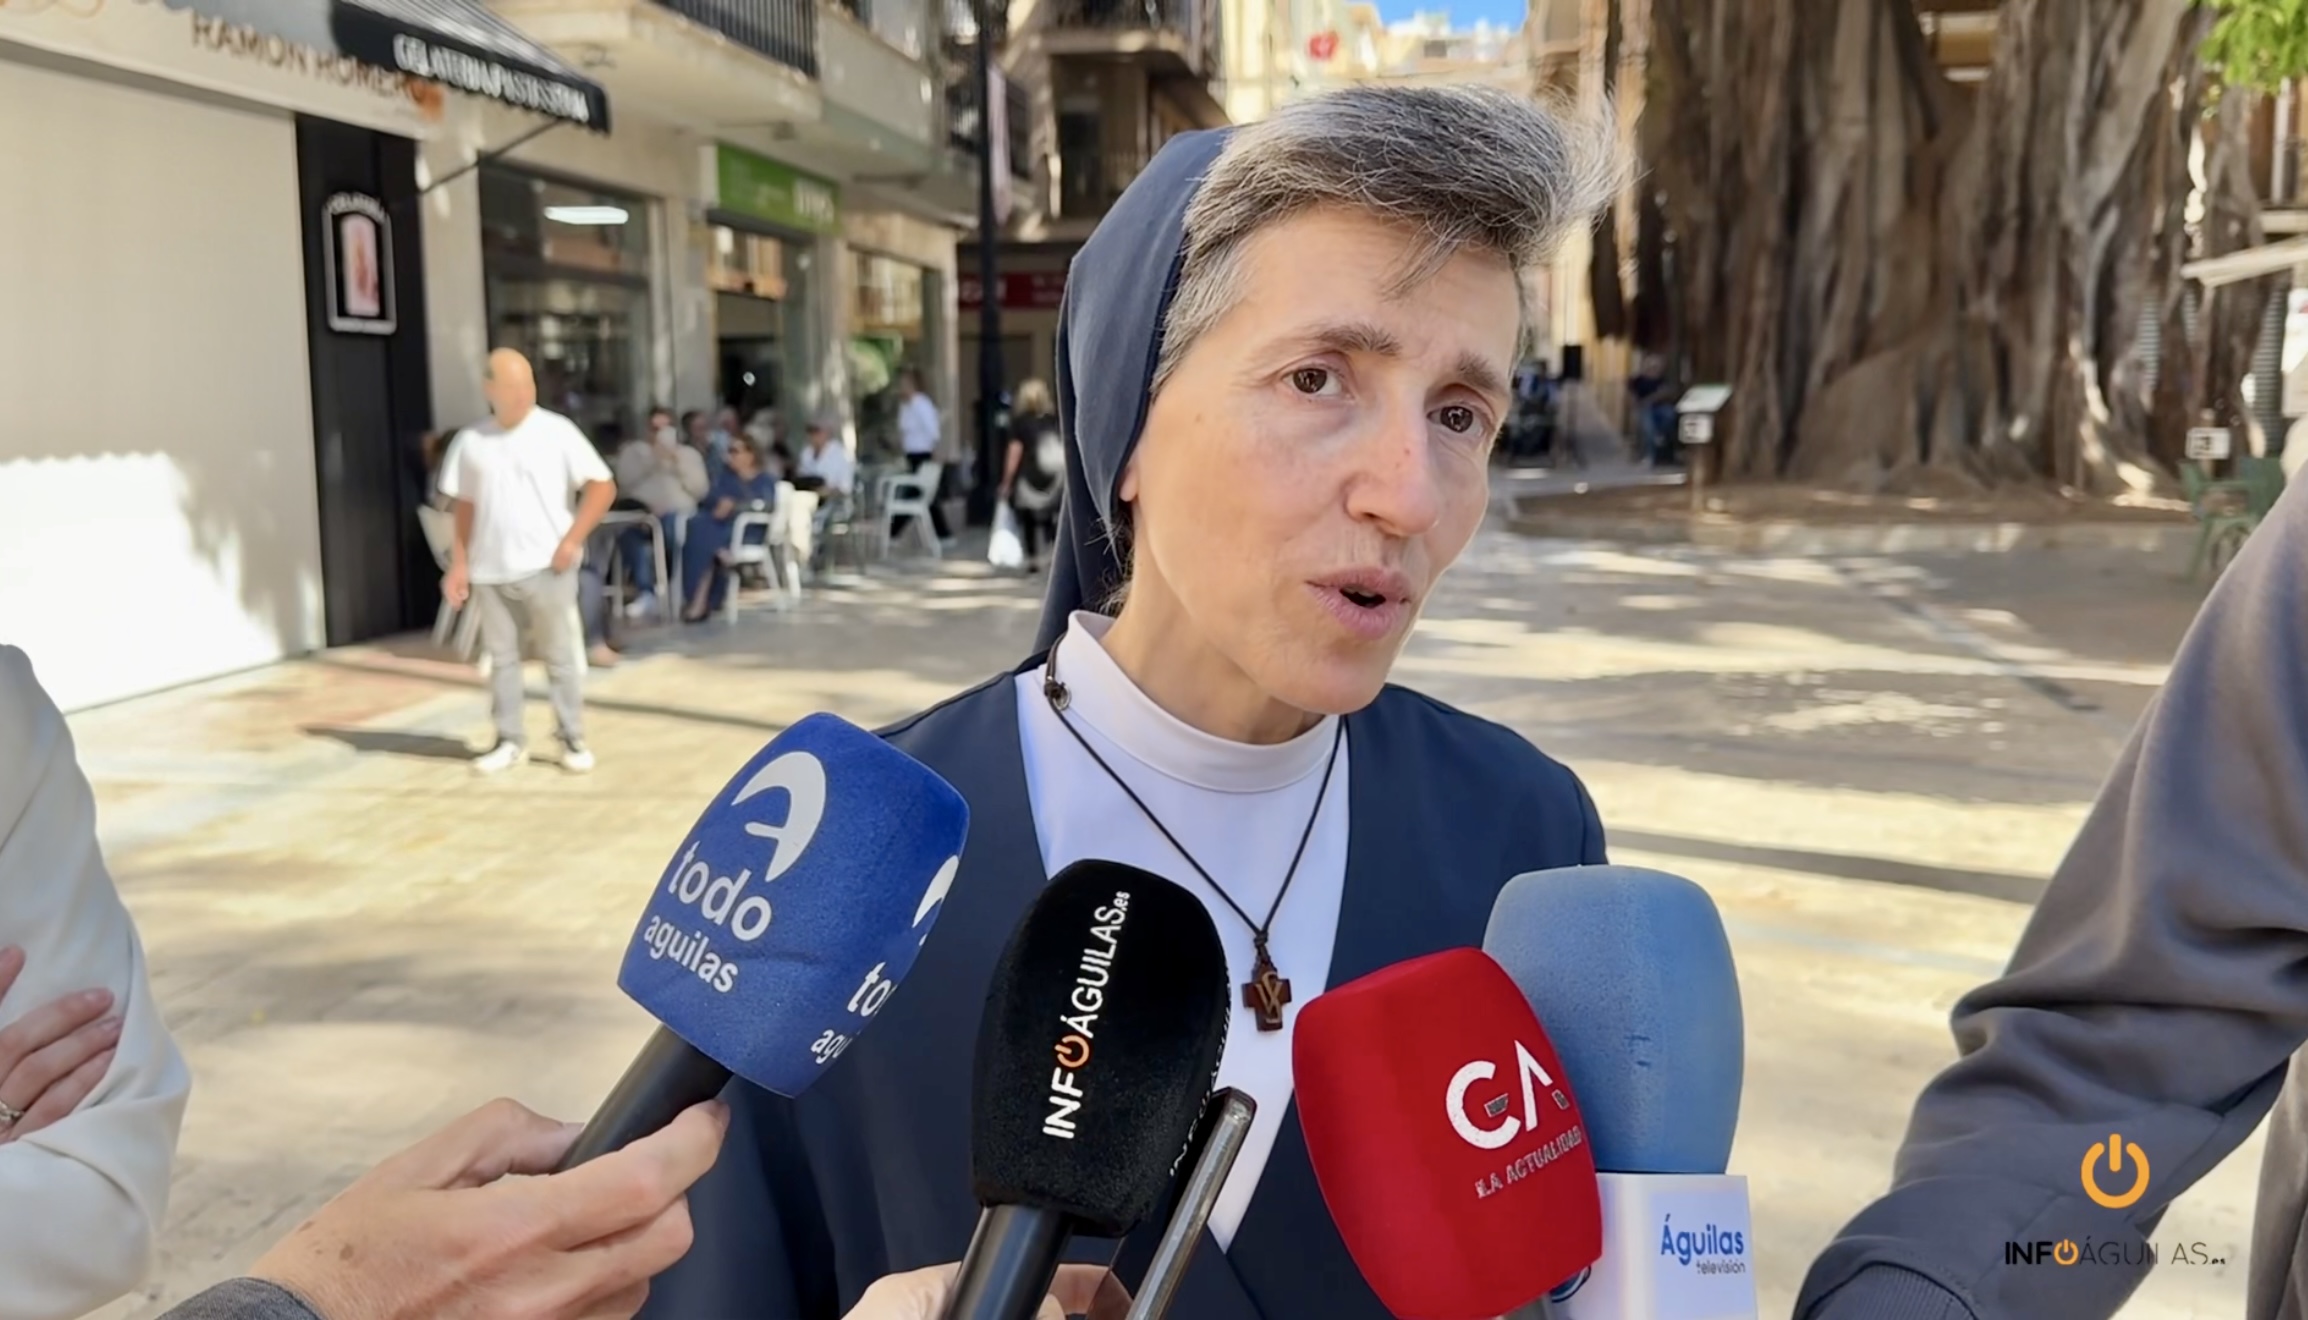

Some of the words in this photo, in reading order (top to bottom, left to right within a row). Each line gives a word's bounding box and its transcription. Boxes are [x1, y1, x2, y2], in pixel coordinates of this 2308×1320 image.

[668, 841, 772, 941] todo
[644, 915, 738, 993] aguilas
[847, 962, 899, 1017] to
[1660, 1213, 1745, 1265] Águilas
[1696, 1259, 1746, 1275] televisión
